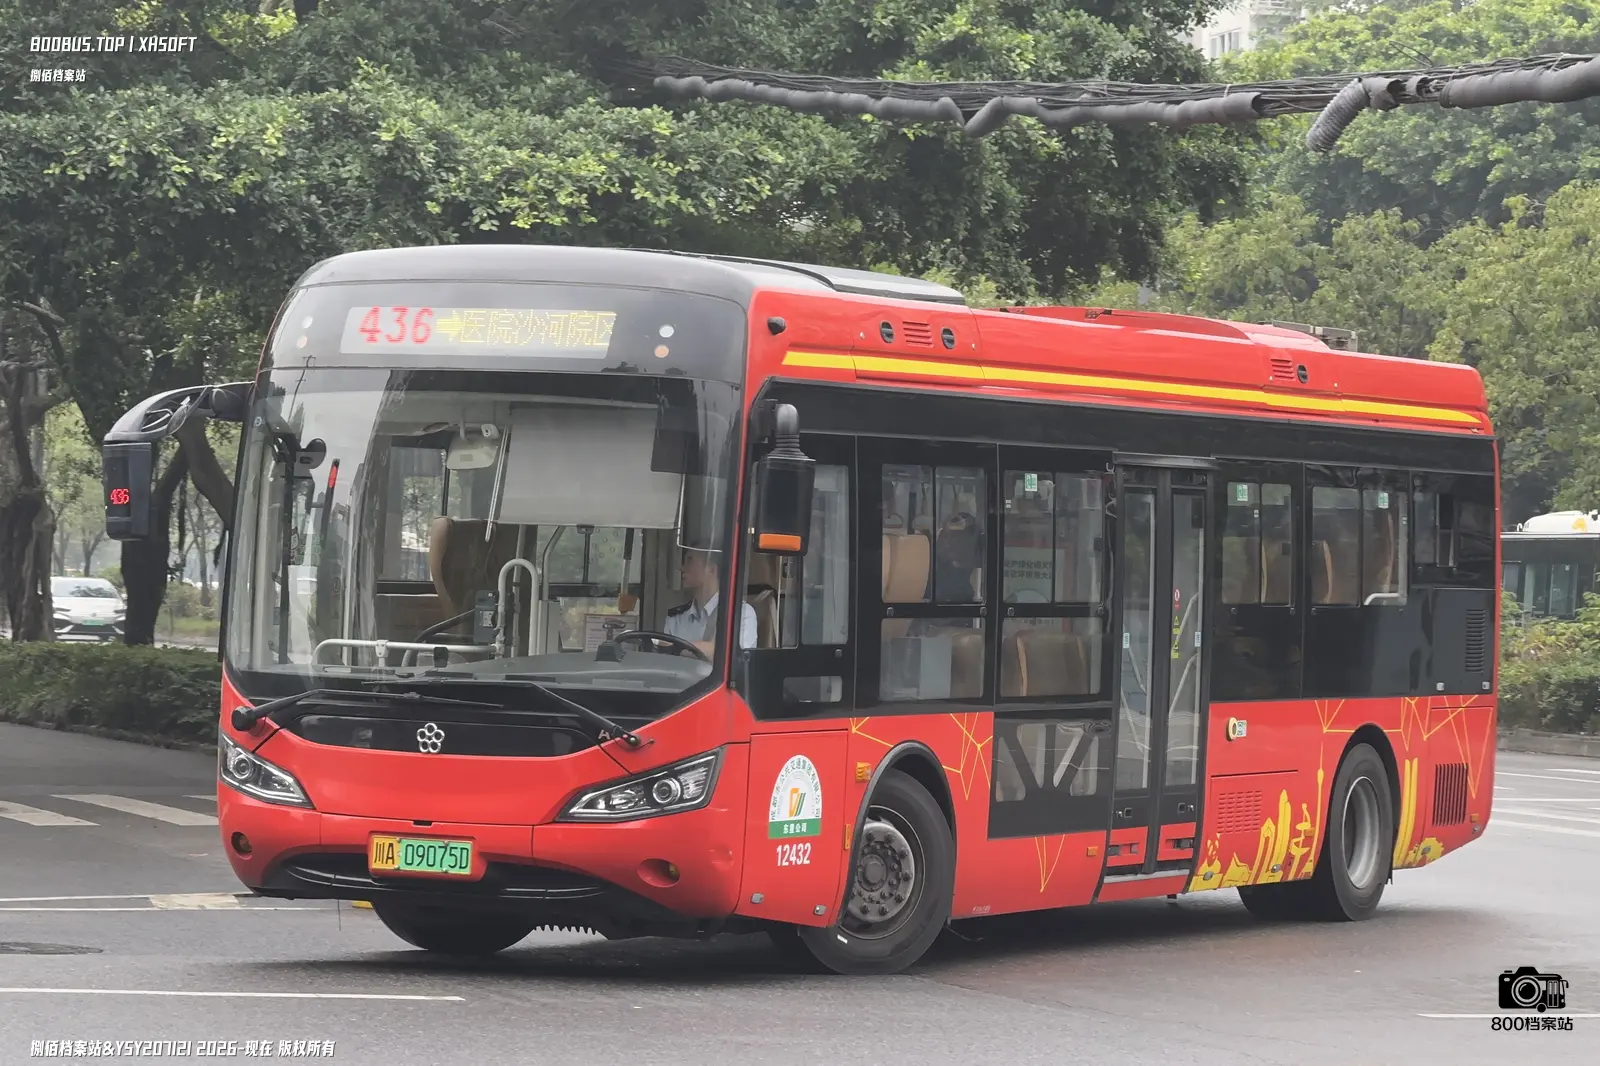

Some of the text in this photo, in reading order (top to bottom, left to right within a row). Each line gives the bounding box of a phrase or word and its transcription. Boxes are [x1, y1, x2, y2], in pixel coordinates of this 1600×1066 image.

[358, 306, 434, 344] 436
[460, 309, 617, 347] 医院沙河院区
[110, 488, 130, 505] 436
[776, 842, 812, 867] 12432
